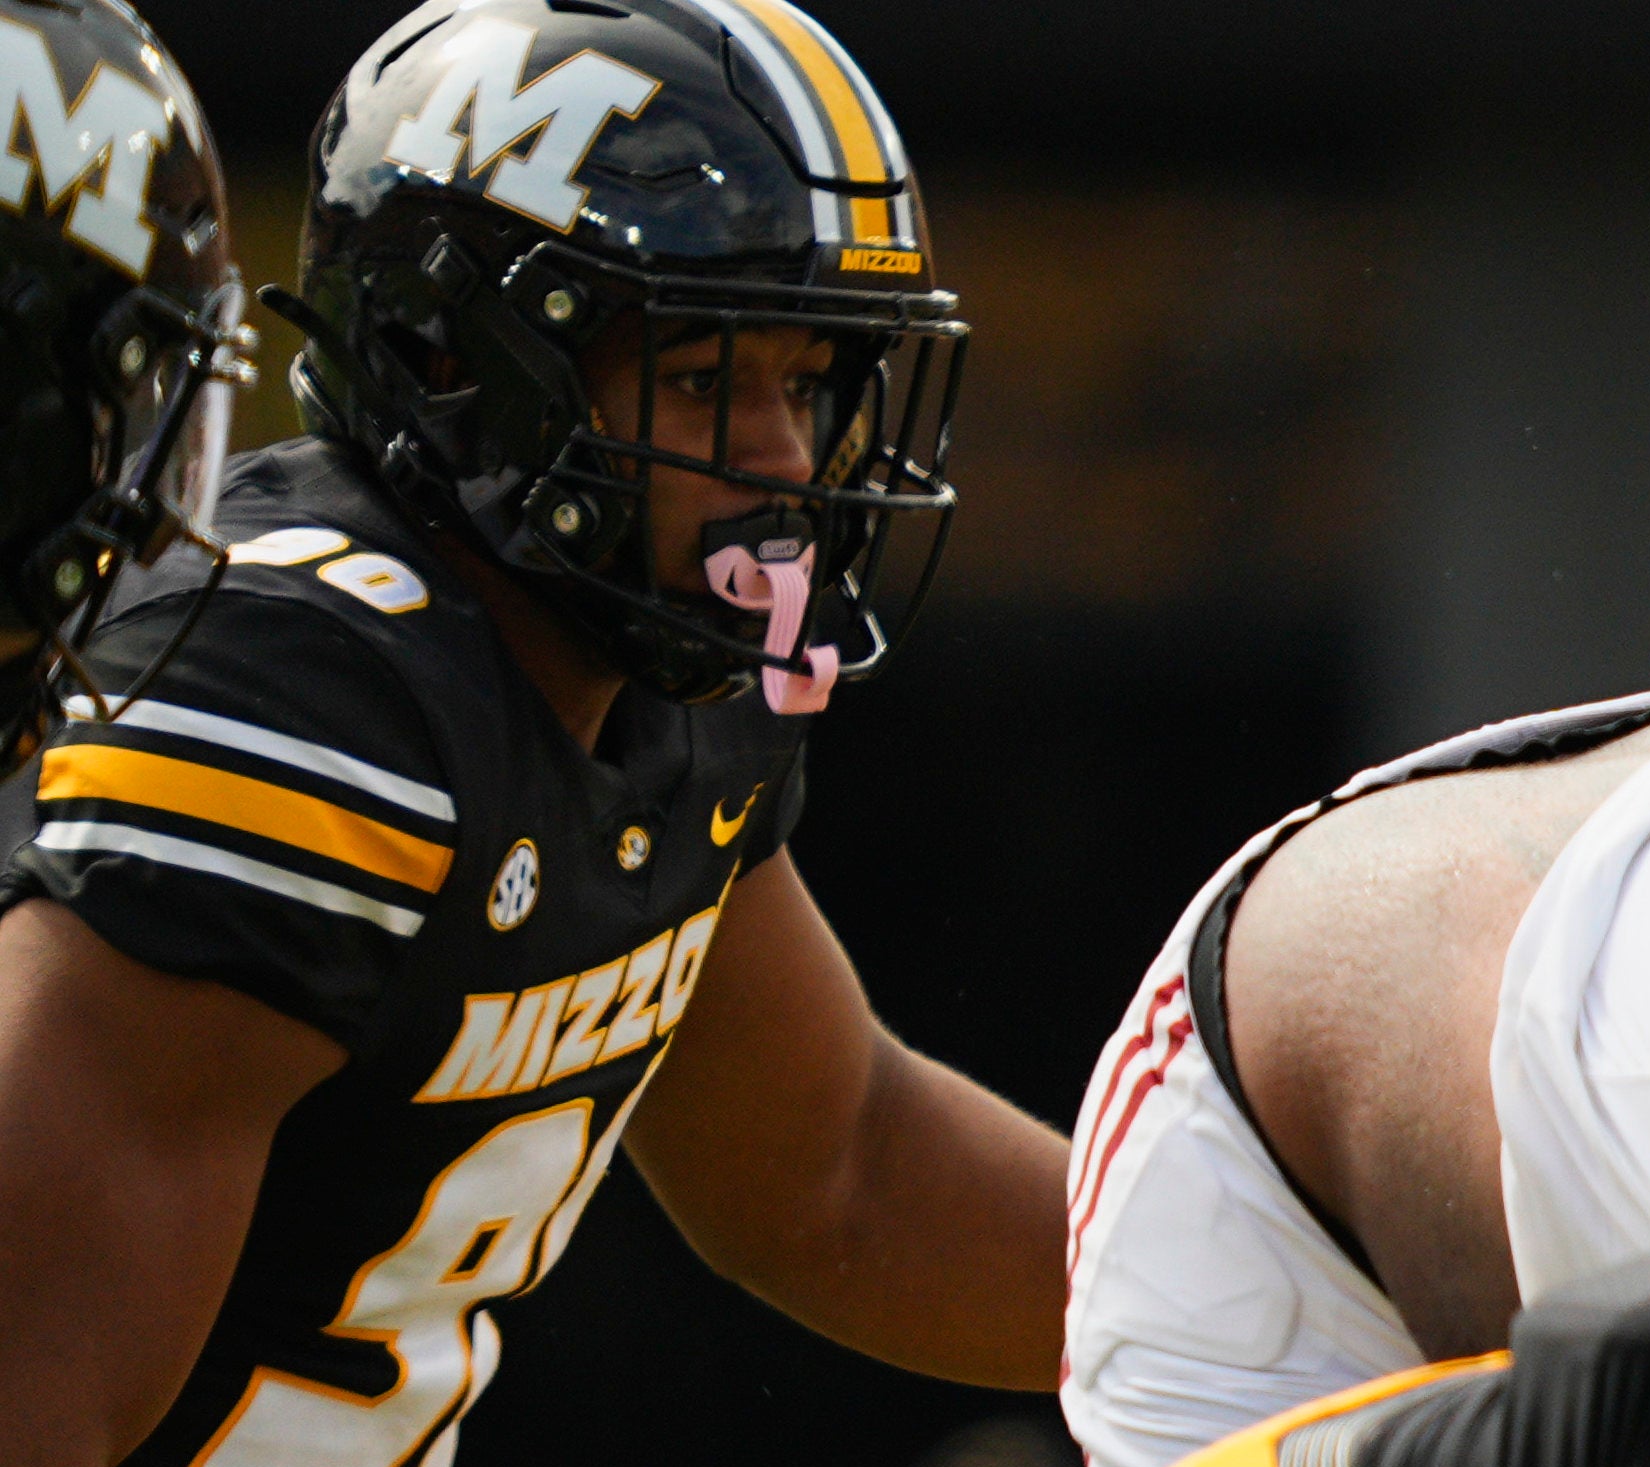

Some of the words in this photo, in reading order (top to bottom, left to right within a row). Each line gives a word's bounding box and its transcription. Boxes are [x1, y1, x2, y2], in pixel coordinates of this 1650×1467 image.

[0, 14, 171, 285] M
[384, 17, 662, 233] M
[840, 248, 922, 275] MIZZOU
[411, 872, 735, 1103] MIZZO
